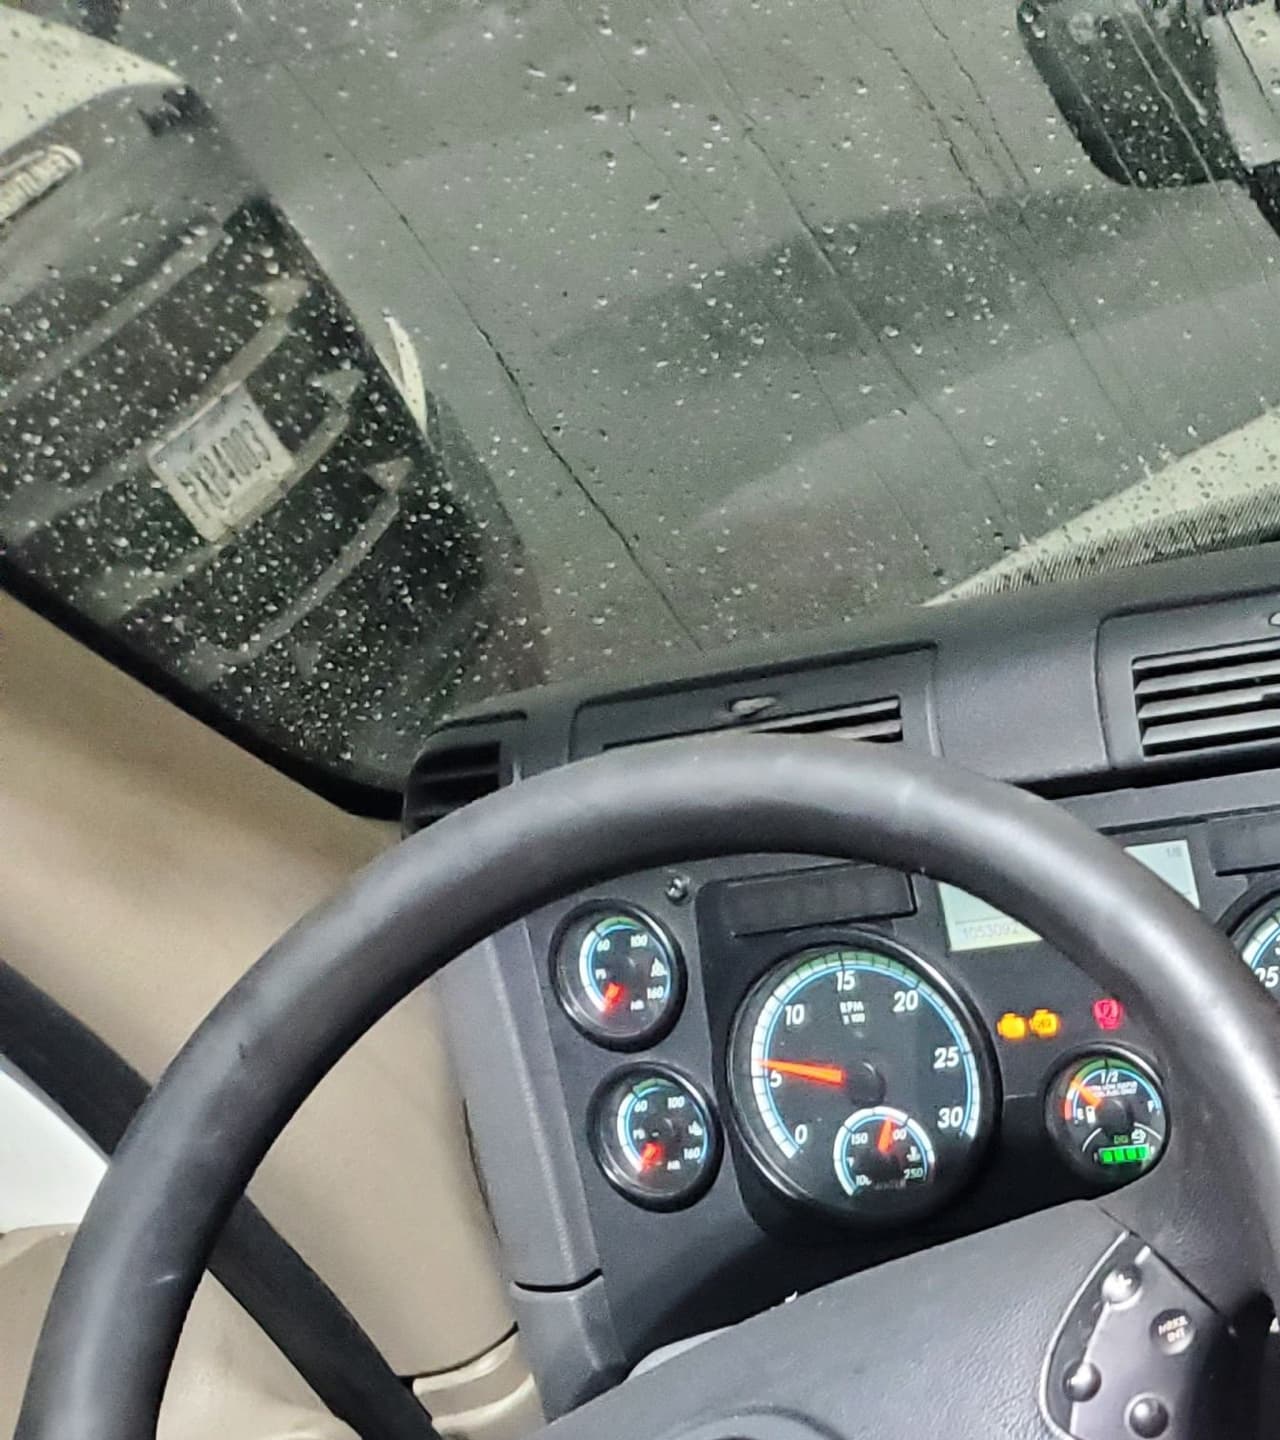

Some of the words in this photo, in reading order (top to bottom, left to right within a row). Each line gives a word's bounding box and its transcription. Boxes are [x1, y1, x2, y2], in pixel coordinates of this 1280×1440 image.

[836, 971, 856, 991] 15
[840, 1001, 864, 1013] RPM
[893, 991, 918, 1012] 20
[785, 1004, 805, 1025] 10
[933, 1048, 960, 1069] 25
[1100, 1071, 1119, 1083] 1/2
[634, 1100, 648, 1113] 60
[667, 1096, 685, 1109] 100
[937, 1107, 963, 1128] 30
[795, 1124, 808, 1145] 0
[851, 1131, 868, 1144] 150
[892, 1129, 907, 1141] 00
[683, 1147, 700, 1160] 160
[904, 1167, 924, 1180] 250
